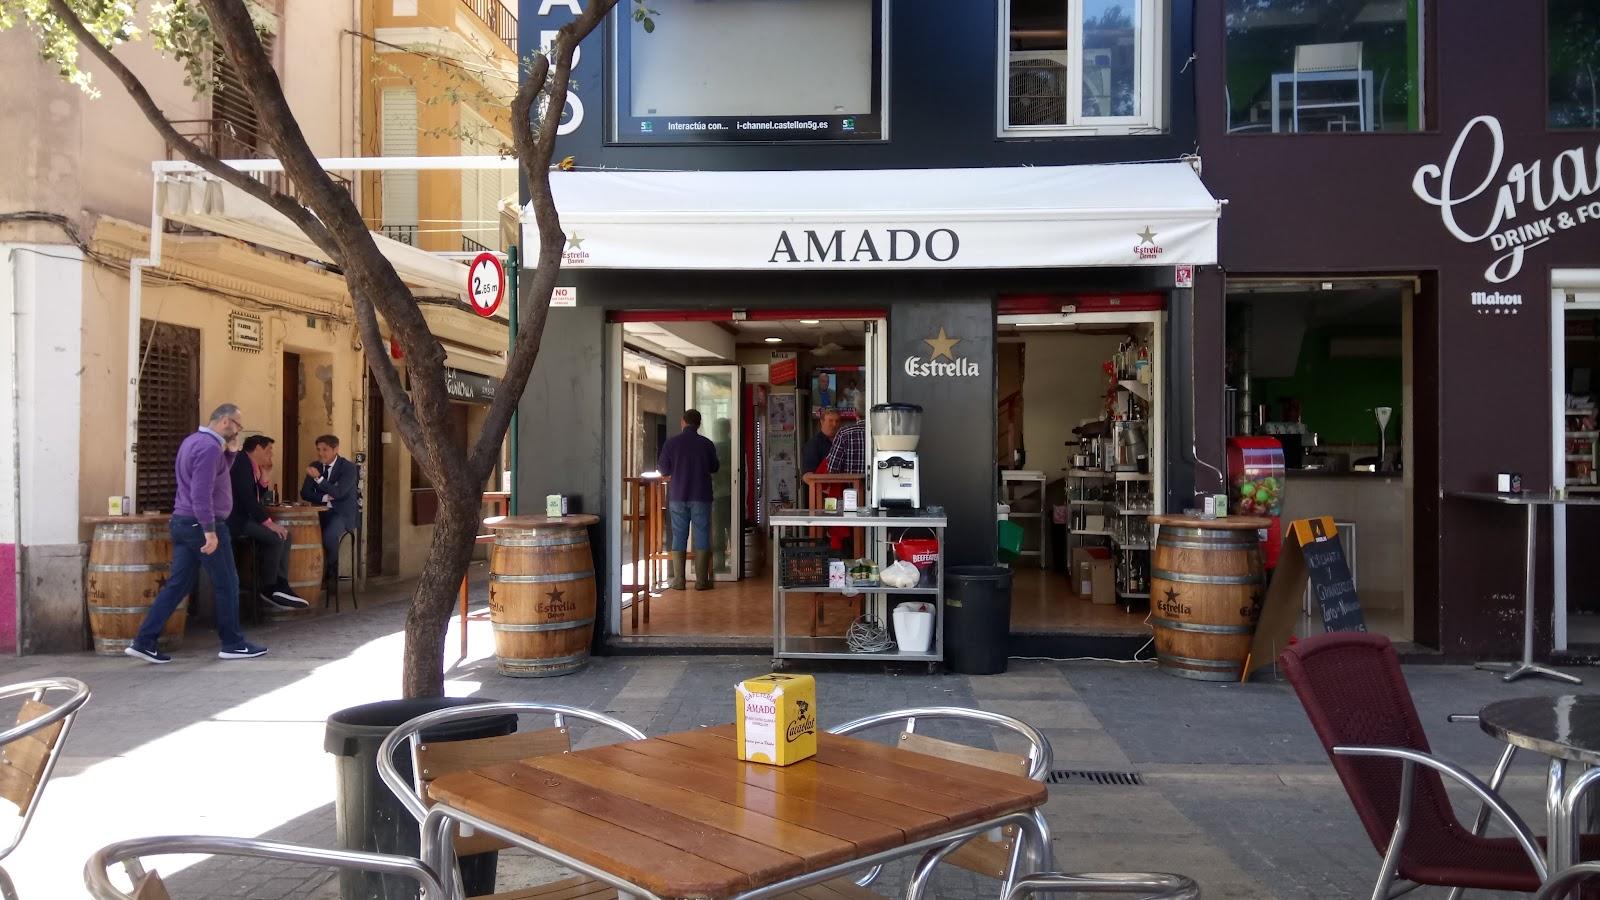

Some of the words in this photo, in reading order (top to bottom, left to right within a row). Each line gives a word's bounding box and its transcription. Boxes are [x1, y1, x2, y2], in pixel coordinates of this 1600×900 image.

[668, 121, 706, 130] Interactúa
[736, 120, 829, 131] i-channel.castellon5g.es
[1411, 114, 1600, 284] Gra
[1489, 217, 1555, 251] DRINK
[1557, 211, 1577, 230] &
[768, 228, 960, 263] AMADO
[1133, 245, 1163, 254] Estrella
[1471, 291, 1522, 305] Mahou
[904, 355, 980, 377] Estrella
[534, 601, 577, 613] Estrella
[1156, 600, 1192, 616] Estrella
[746, 703, 776, 715] AMADO
